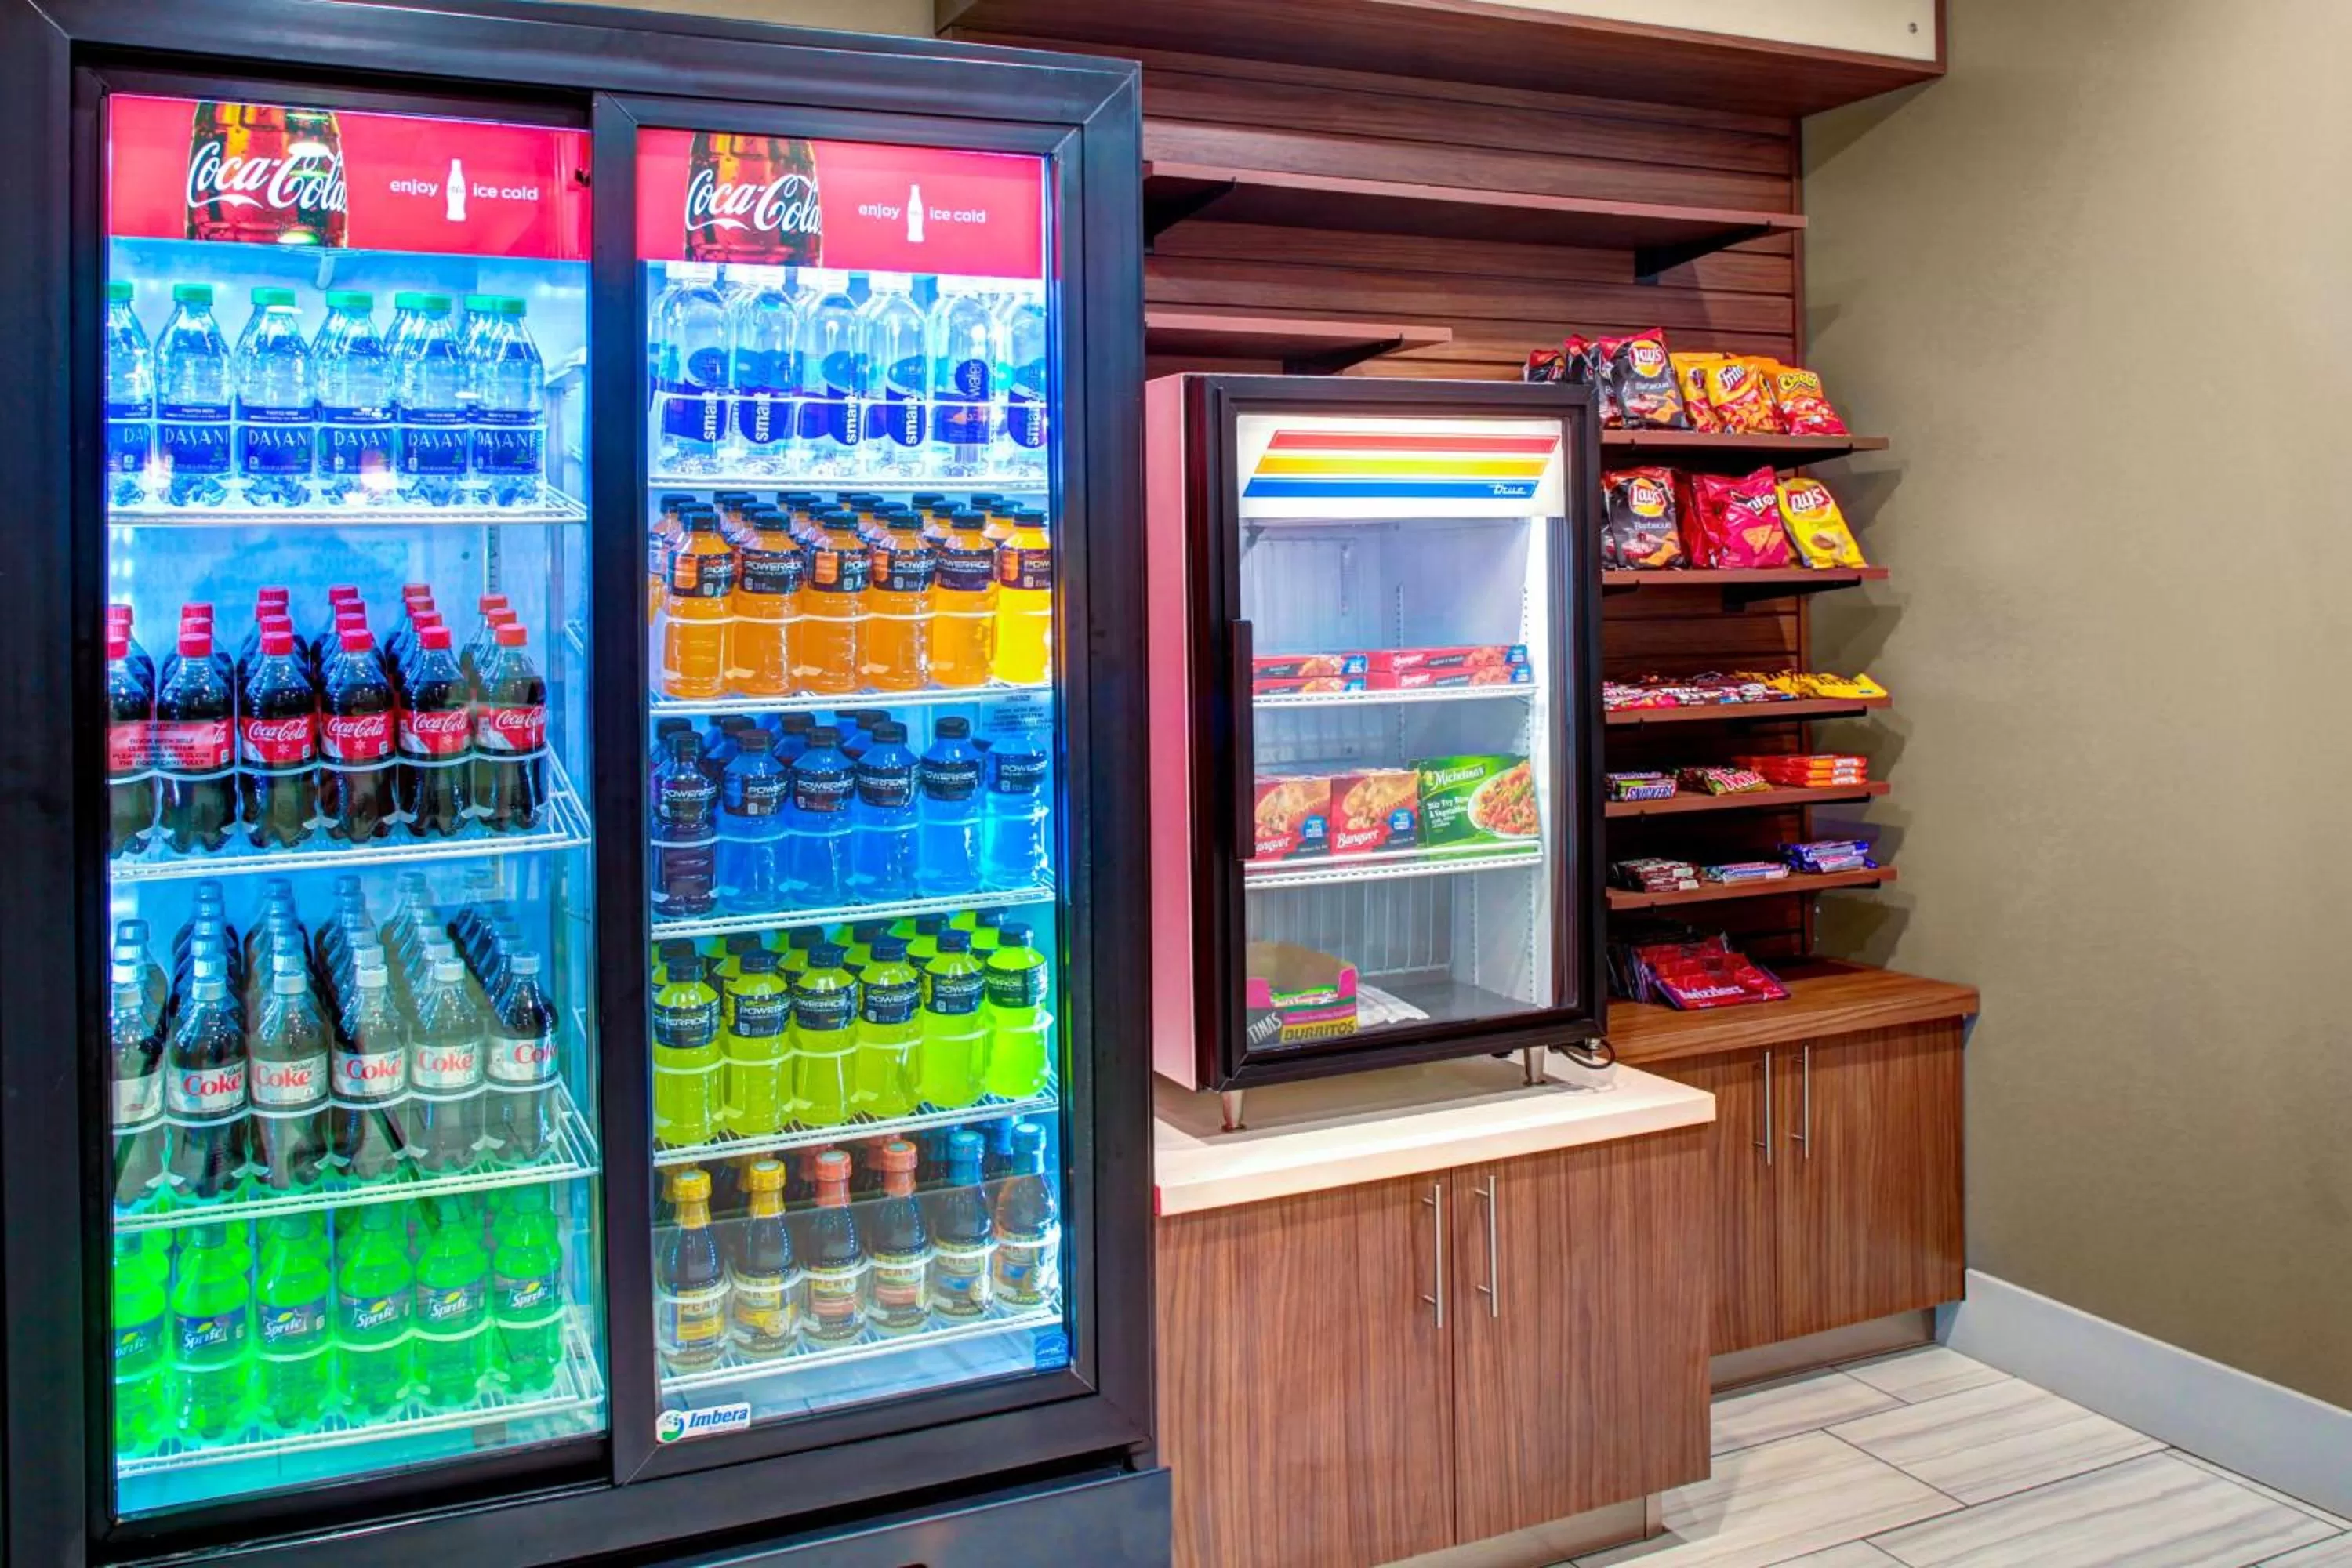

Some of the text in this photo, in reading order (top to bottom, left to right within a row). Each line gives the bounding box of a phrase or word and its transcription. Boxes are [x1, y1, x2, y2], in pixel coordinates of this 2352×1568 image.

[186, 140, 347, 213] Coca-Cola
[390, 179, 539, 201] enjoy ice cold
[685, 169, 822, 234] Coca-Cola
[858, 204, 986, 223] enjoy ice cold
[334, 430, 390, 450] DASAN
[249, 719, 308, 742] Coca-Cola
[326, 714, 385, 738] Coca-Cola
[413, 709, 468, 733] Coca-Cola
[1256, 837, 1290, 853] anquet
[1283, 1021, 1355, 1041] BURRITOS
[346, 1058, 402, 1080] Coke
[419, 1048, 474, 1073] Coke
[183, 1072, 243, 1096] Coke
[254, 1065, 312, 1088] Coke
[431, 1294, 469, 1318] Sprite
[511, 1286, 548, 1308] Sprite
[264, 1312, 303, 1337] Sprite
[355, 1304, 395, 1329] Sprite
[183, 1327, 224, 1348] Sprite
[688, 1408, 748, 1428] Imbera
